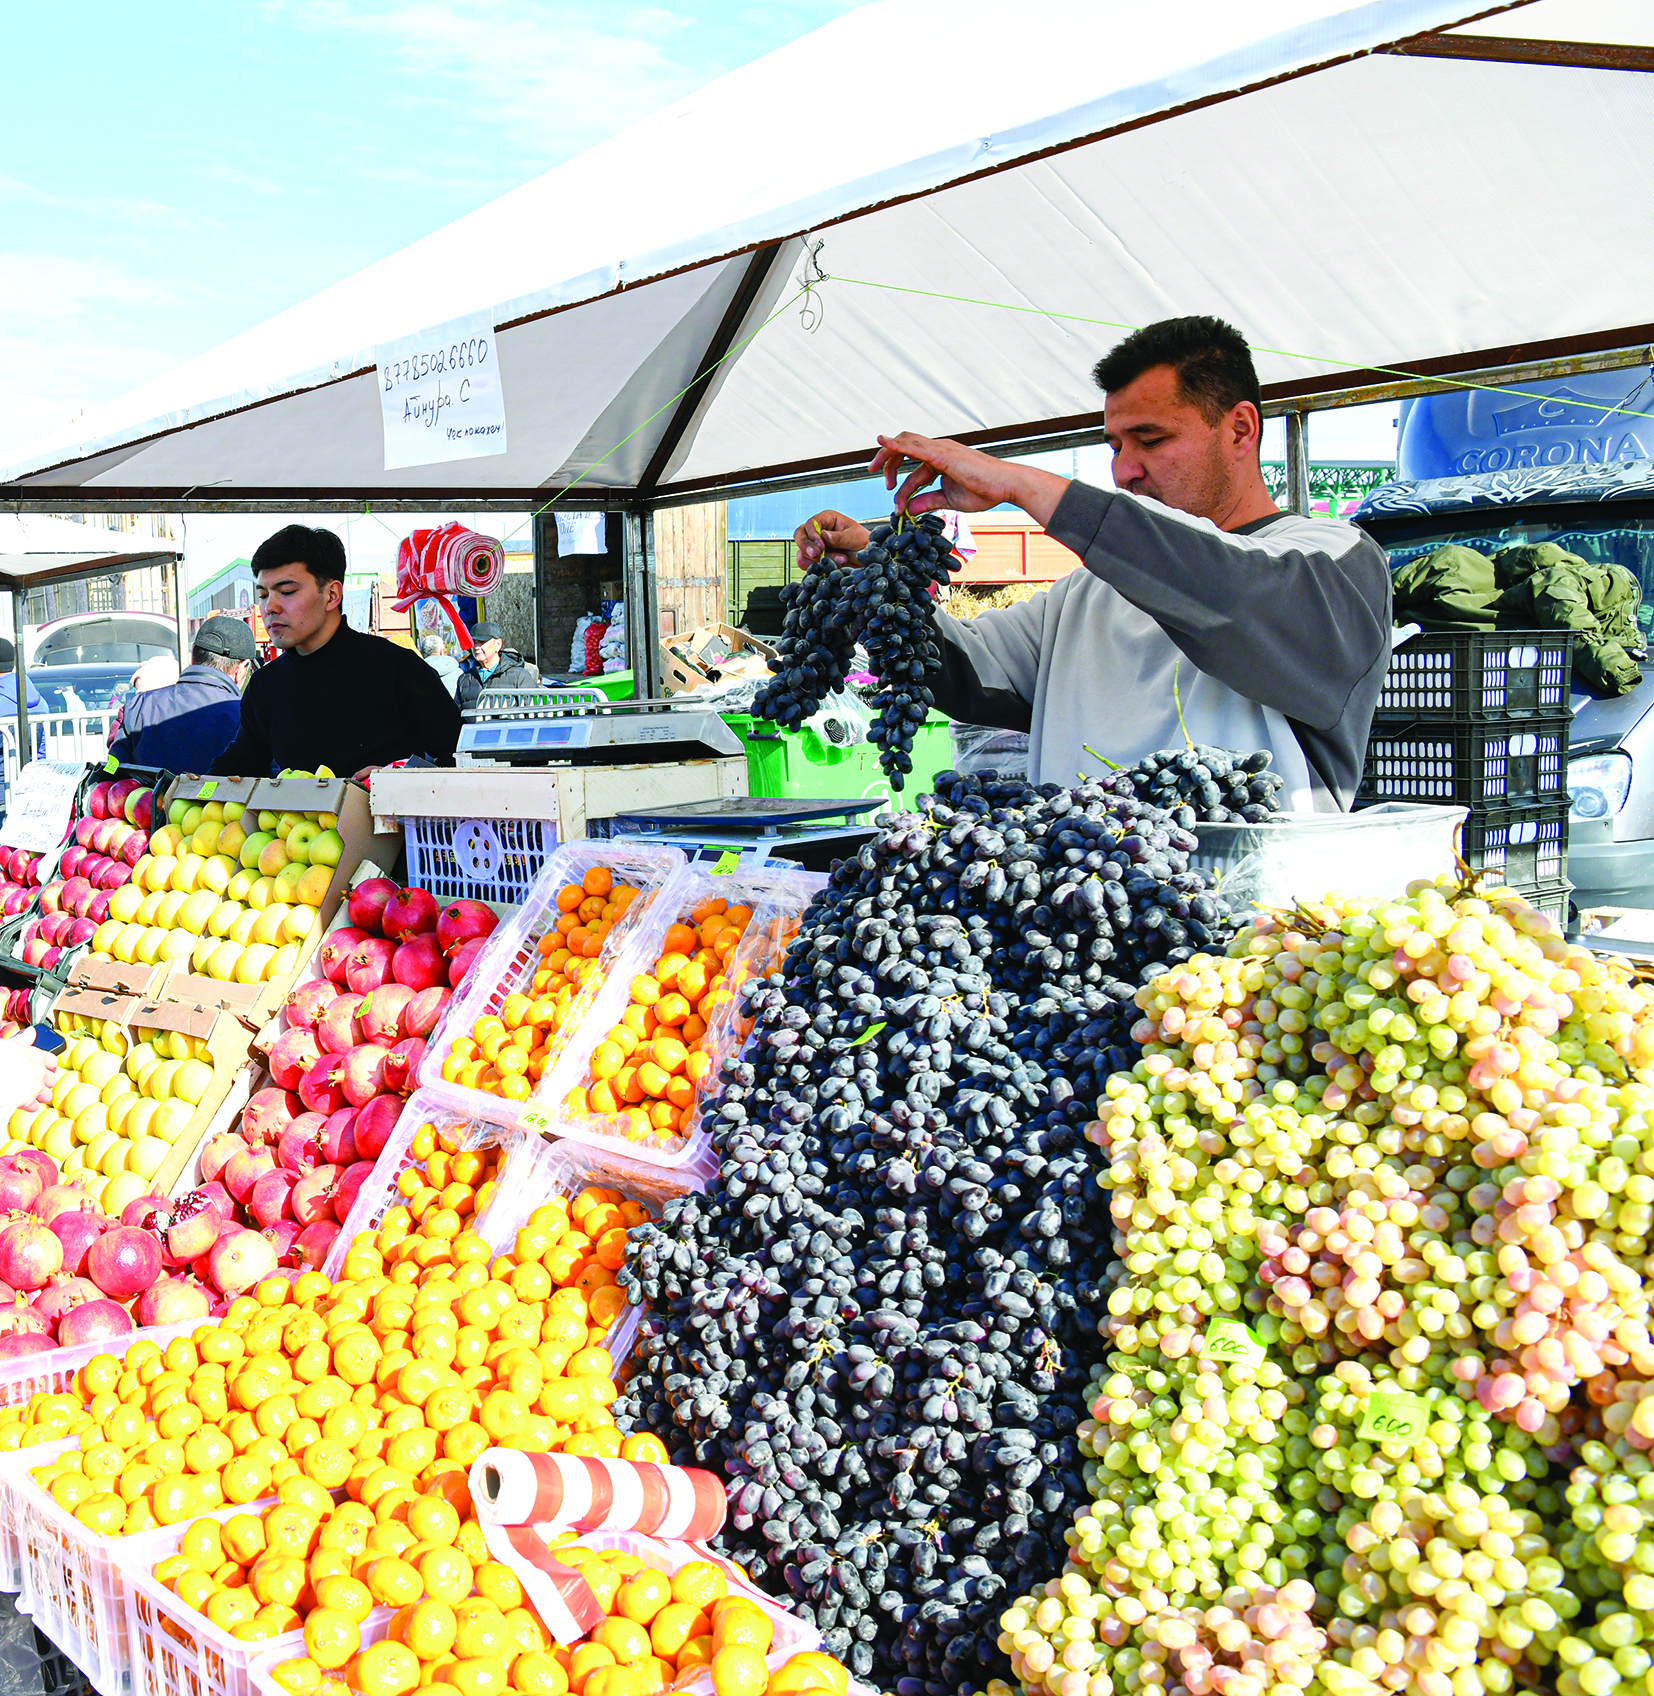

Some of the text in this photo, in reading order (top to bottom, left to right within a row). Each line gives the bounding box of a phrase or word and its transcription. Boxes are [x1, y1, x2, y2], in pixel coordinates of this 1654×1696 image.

[383, 338, 488, 392] 87785026660
[1456, 432, 1649, 475] CORONA
[1209, 1336, 1249, 1355] 600
[1372, 1414, 1412, 1436] 600
